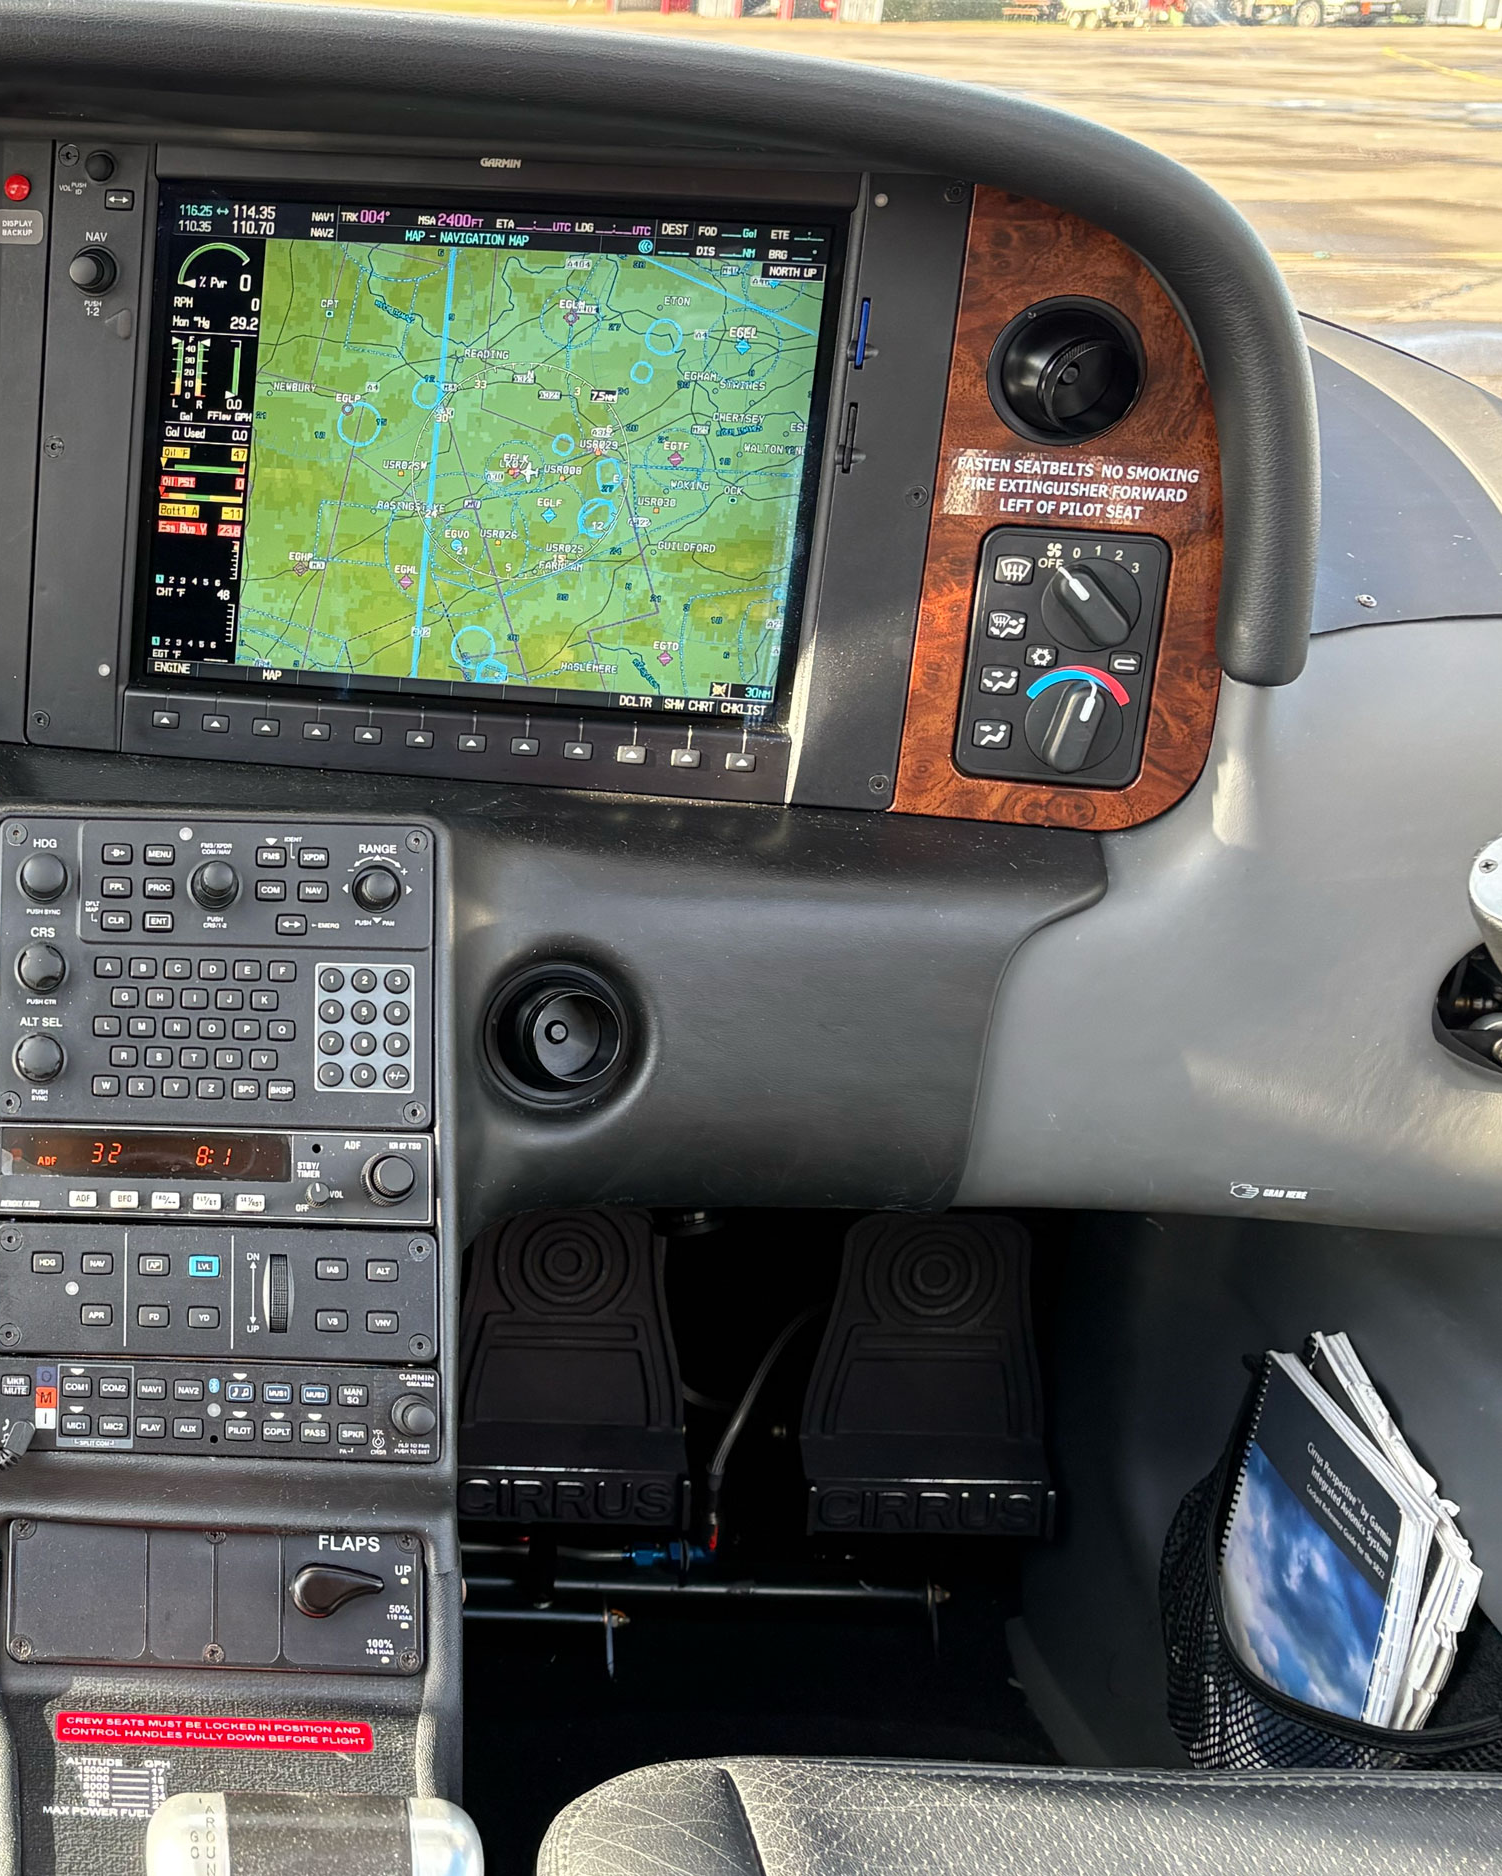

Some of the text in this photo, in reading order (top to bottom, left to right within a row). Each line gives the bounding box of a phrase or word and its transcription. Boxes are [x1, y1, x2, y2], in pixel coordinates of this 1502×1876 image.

[480, 158, 521, 169] GARMIN
[179, 205, 334, 222] 116.25 114.35 NAV1
[2, 220, 32, 228] DISPLAY
[178, 221, 333, 238] 110.35 110.70 NAV2
[2, 228, 32, 236] BACKUP
[85, 232, 108, 242] NAV
[769, 267, 816, 278] NORTH UP
[664, 297, 690, 306] ETON
[957, 457, 1199, 483] FASTEN SEATBELTS NO SMOKING
[963, 477, 1187, 502] FIRE EXTINGUISHER FORWARD
[1000, 498, 1144, 519] LEFT OF PILOT SEAT
[658, 542, 716, 553] GUILDFORD
[1038, 558, 1064, 569] OFF
[653, 641, 679, 651] EGTD
[154, 662, 190, 674] ENGINE
[619, 696, 652, 708] DCLTR
[720, 703, 766, 716] CHKLIST
[33, 839, 57, 848] HDG
[359, 844, 397, 854] RANGE
[148, 850, 171, 859] MENU
[148, 884, 171, 892] PROC
[30, 928, 55, 937] CRS
[20, 1017, 62, 1027] ALT SEL
[37, 1155, 57, 1166] ADF
[65, 1383, 88, 1391] COM1
[102, 1384, 126, 1392] COM2
[67, 1422, 85, 1430] MIC1
[228, 1426, 252, 1435] PILOT
[1307, 1442, 1324, 1466] Cirrus
[1361, 1504, 1369, 1521] by
[1370, 1516, 1392, 1547] Garmin
[1311, 1465, 1388, 1562] Integrated Avionics System
[318, 1535, 380, 1552] FLAPS
[1343, 1528, 1357, 1548] Guide
[1373, 1562, 1385, 1580] SR22
[395, 1565, 411, 1576] UP
[66, 1717, 103, 1725] CREW
[106, 1718, 145, 1726] SEATS
[206, 1722, 256, 1730] LOCKED
[274, 1724, 332, 1733] POSITION
[335, 1726, 360, 1734] AND
[62, 1728, 121, 1737] CONTROL
[125, 1730, 182, 1739] HANDLES
[186, 1732, 224, 1740] FULLY
[227, 1733, 265, 1741] DOWN
[269, 1735, 319, 1743] BEFORE
